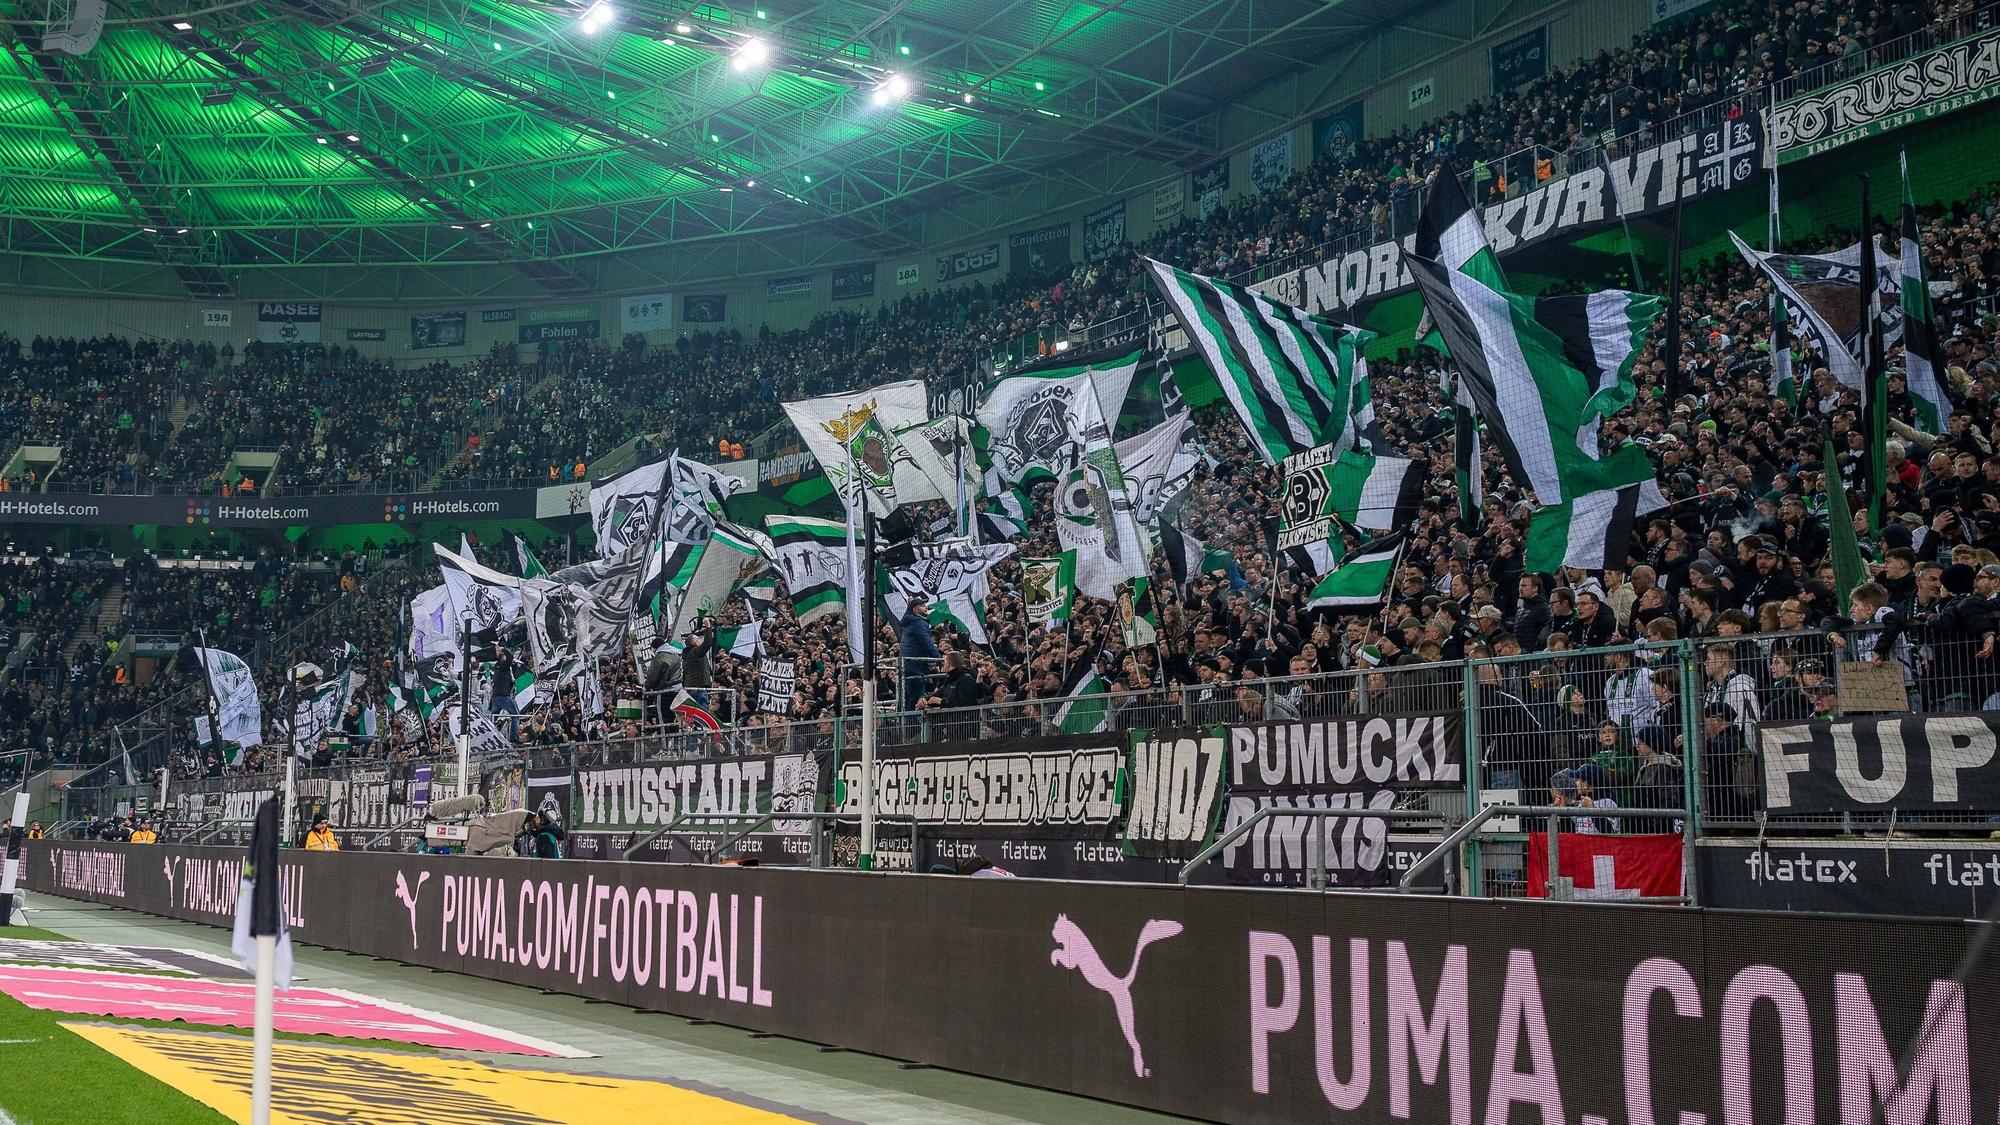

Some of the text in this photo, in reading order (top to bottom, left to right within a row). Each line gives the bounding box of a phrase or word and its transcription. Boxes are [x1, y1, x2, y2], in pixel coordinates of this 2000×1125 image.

[1411, 84, 1431, 103] 17A
[1775, 35, 2000, 152] BORUSSIA
[1807, 126, 1869, 155] IMMER
[1881, 111, 1915, 131] UND
[1483, 133, 1698, 254] KURVE
[898, 269, 917, 281] 18A
[207, 313, 229, 322] 19A
[260, 303, 320, 316] AASEE
[540, 325, 579, 338] Fohlen
[0, 501, 99, 516] H-Hotels.com
[218, 505, 309, 519] H-Hotels.com
[412, 500, 500, 515] H-Hotels.com
[1231, 716, 1460, 786] PUMUCKL
[1761, 716, 1998, 809] FUP
[579, 761, 767, 826] VITUSSTADT
[1223, 789, 1396, 872] PINKIS
[576, 836, 598, 849] flatex
[690, 836, 716, 852] flatex
[936, 839, 977, 859] flatex
[1001, 840, 1047, 862] flatex
[1074, 841, 1125, 863] flatex
[1263, 872, 1338, 884] ON TR
[1745, 852, 1857, 884] flatex
[441, 874, 773, 1009] PUMA.COM/FOOTBALL
[1248, 929, 1972, 1125] PUMA.COM
